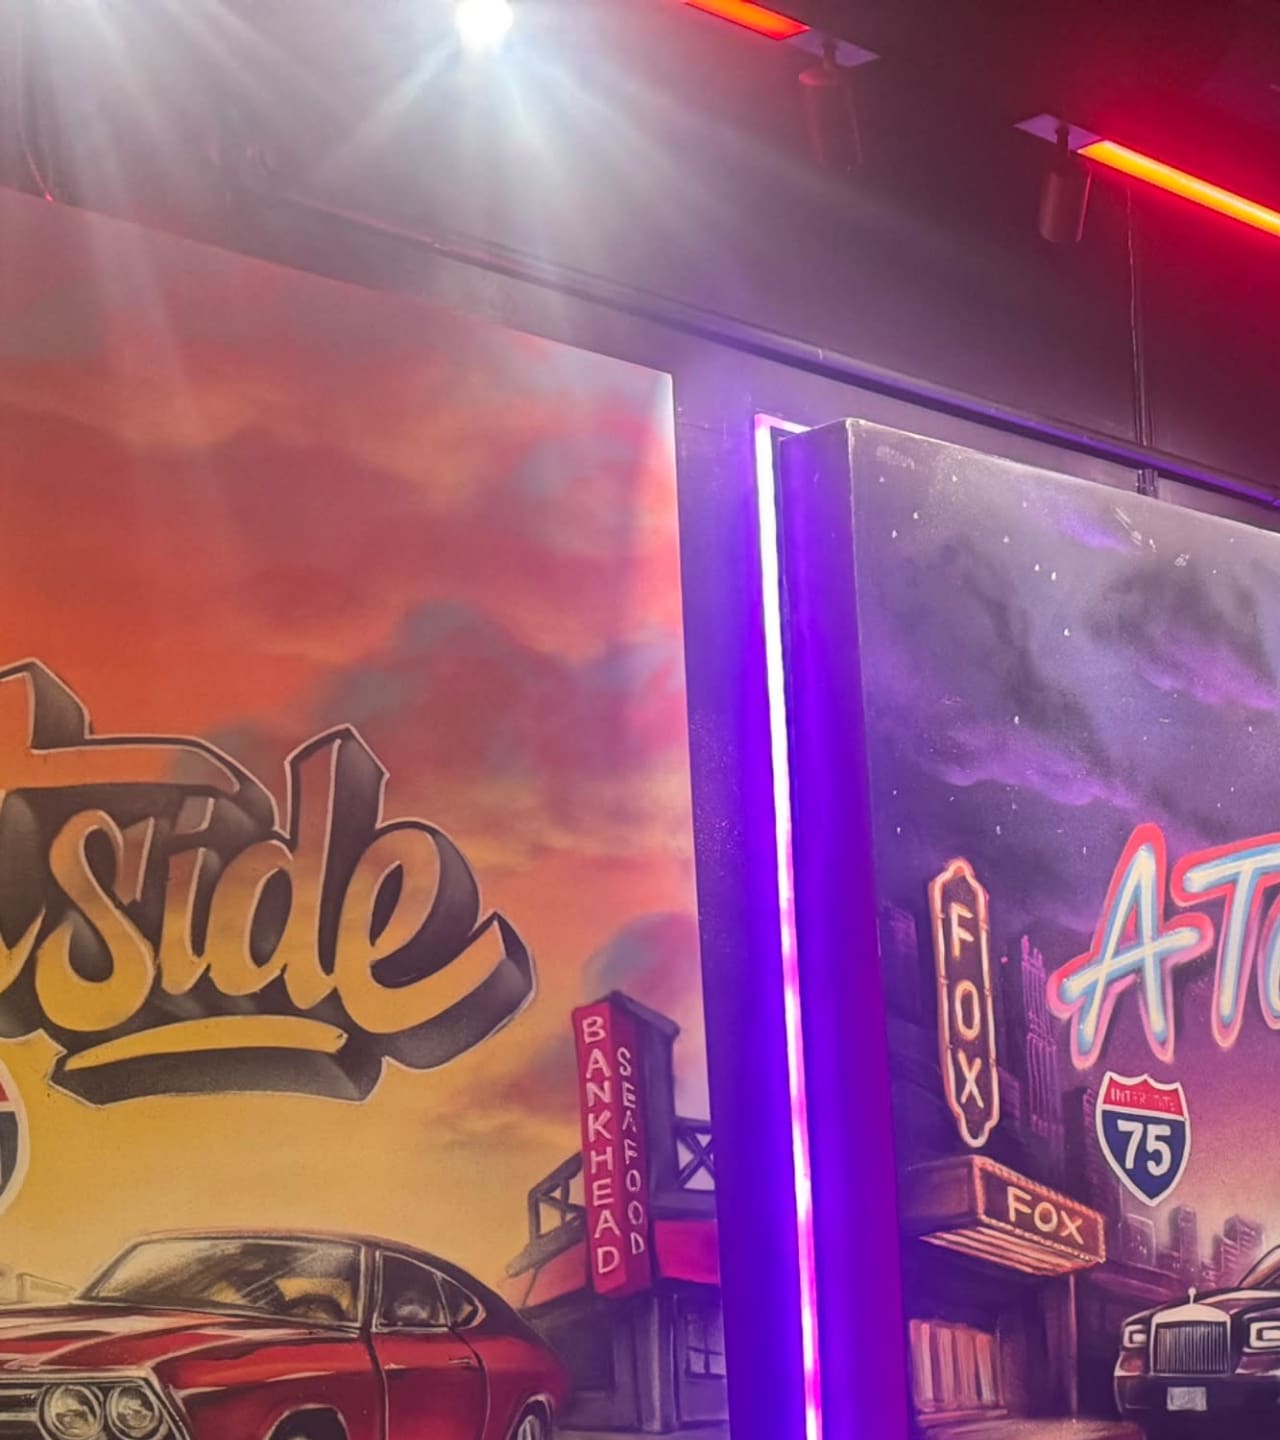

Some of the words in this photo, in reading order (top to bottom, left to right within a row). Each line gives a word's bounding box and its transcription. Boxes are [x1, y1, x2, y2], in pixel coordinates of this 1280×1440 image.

[951, 902, 984, 1109] FOX
[582, 1016, 621, 1274] BANKHEAD
[617, 1047, 645, 1254] SEAFOOD
[1007, 1186, 1084, 1244] FOX
[1117, 1119, 1172, 1176] 75
